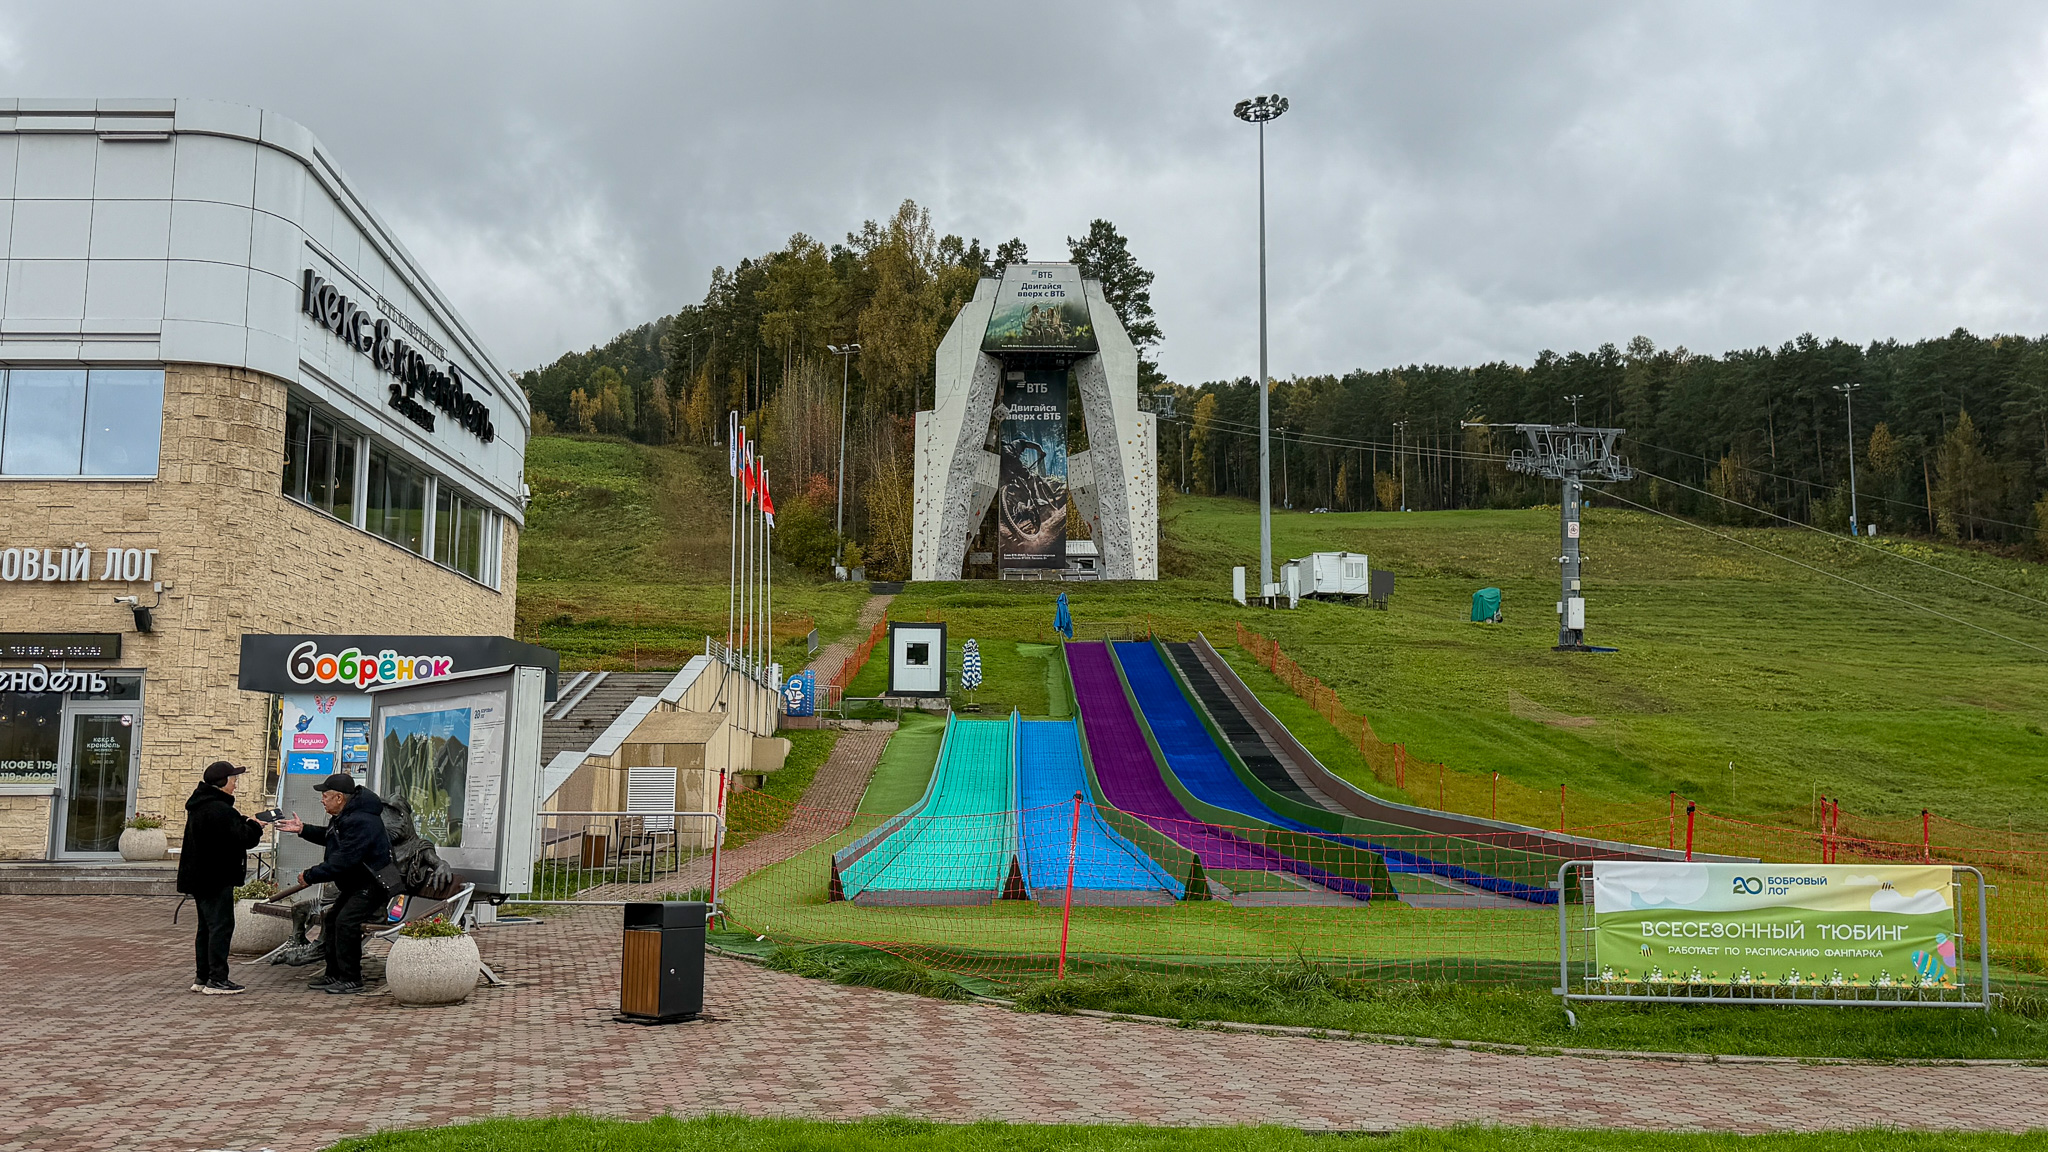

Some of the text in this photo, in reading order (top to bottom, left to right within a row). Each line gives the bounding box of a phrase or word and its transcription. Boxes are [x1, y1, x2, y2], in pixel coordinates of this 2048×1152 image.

[1038, 271, 1053, 279] ВТБ
[1021, 282, 1062, 291] Двигайся
[1050, 290, 1066, 298] ВТБ
[1026, 383, 1048, 394] ВТБ
[1009, 403, 1057, 413] Двигайся
[1043, 412, 1062, 421] ВТБ
[0, 541, 160, 582] ОВЫЙ ЛОГ
[288, 641, 453, 688] бобрёнок
[298, 737, 324, 745] Игрушки
[1, 760, 34, 769] КОФЕ
[1733, 876, 1828, 895] 20 БОБРОВЫЙ
[1768, 887, 1789, 896] ЛОГ
[1641, 920, 1909, 941] ВСЕСЕЗОННЫЙ ТЮБИНГ
[1668, 946, 1884, 958] РАБОТАЕТ ПО РАСПИСАНИЮ ФАНПАРКА
